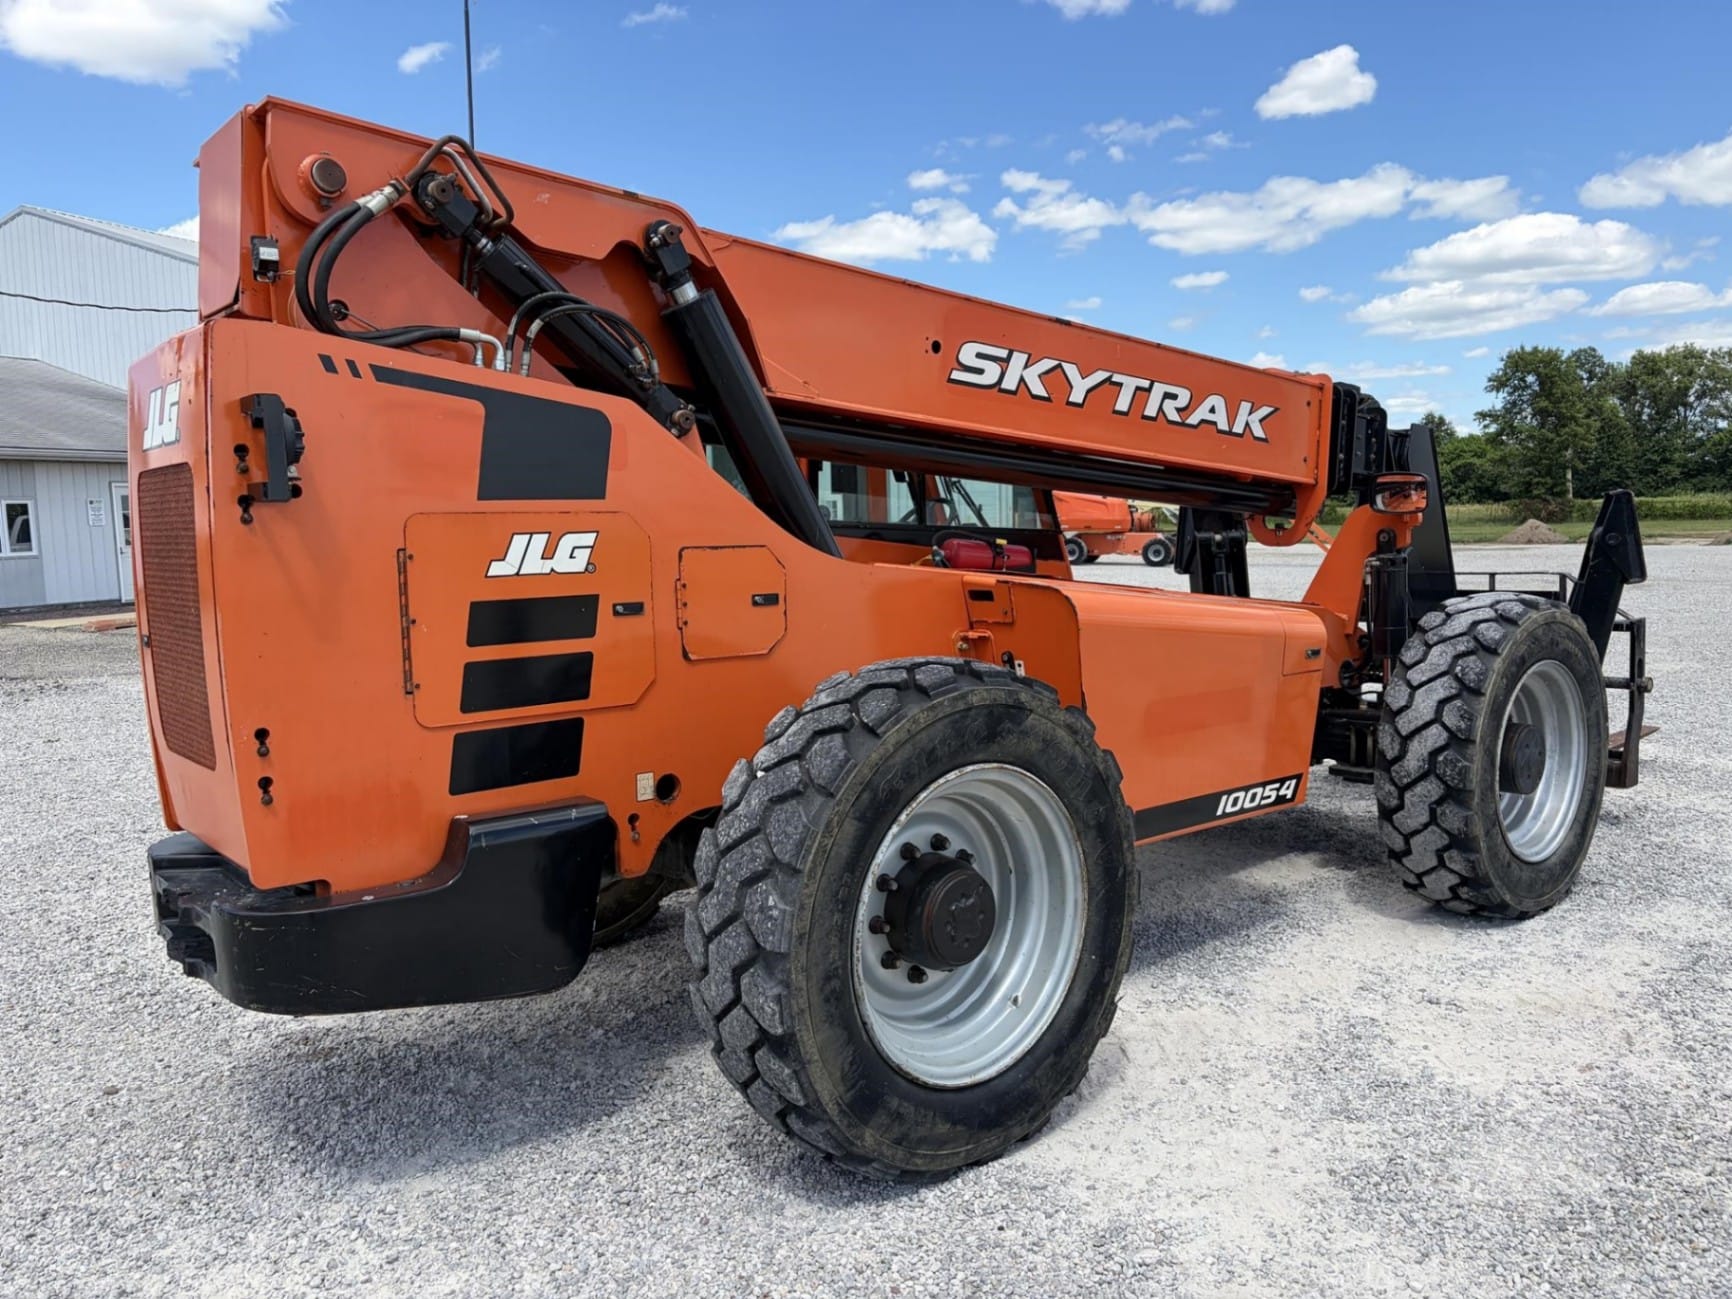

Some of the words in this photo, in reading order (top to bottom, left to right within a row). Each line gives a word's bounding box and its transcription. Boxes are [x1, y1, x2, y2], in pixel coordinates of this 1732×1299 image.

[142, 380, 180, 452] JLG
[948, 341, 1279, 441] SKYTRAK
[485, 531, 598, 578] JLG
[1216, 779, 1297, 816] 10054
